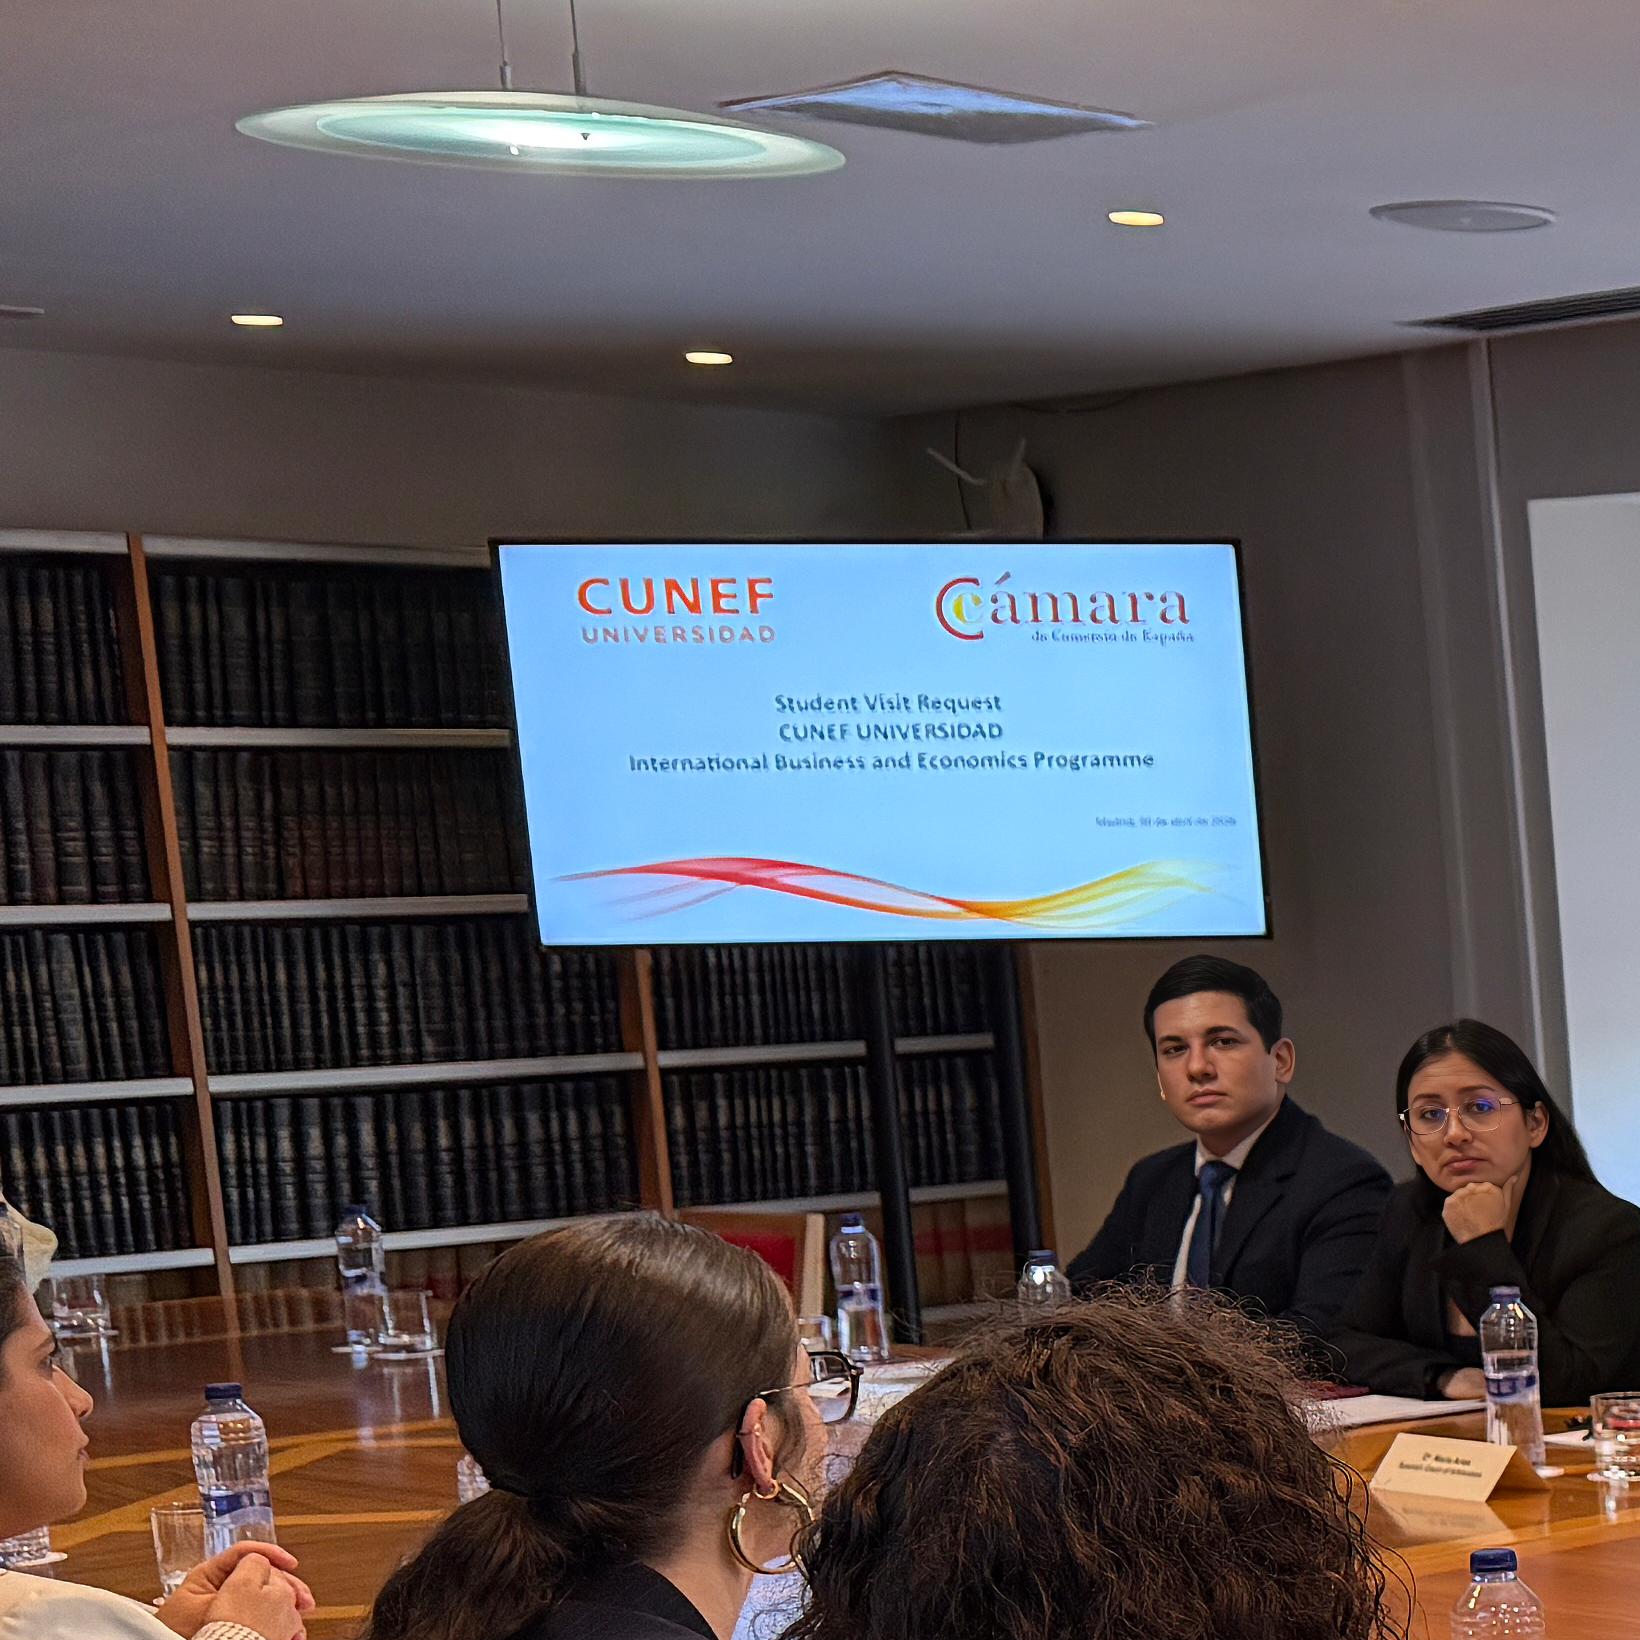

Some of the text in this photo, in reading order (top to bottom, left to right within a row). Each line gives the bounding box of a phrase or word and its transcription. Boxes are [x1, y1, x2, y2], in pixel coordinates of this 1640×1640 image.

[577, 577, 773, 615] CUNEF
[935, 571, 1190, 640] Cámara
[582, 625, 775, 644] UNIVERSIDAD
[775, 694, 1001, 713] Student Visit Request
[779, 723, 1003, 741] CUNEF UNIVERSIDAD
[629, 751, 1154, 772] International Business and Economics Programme
